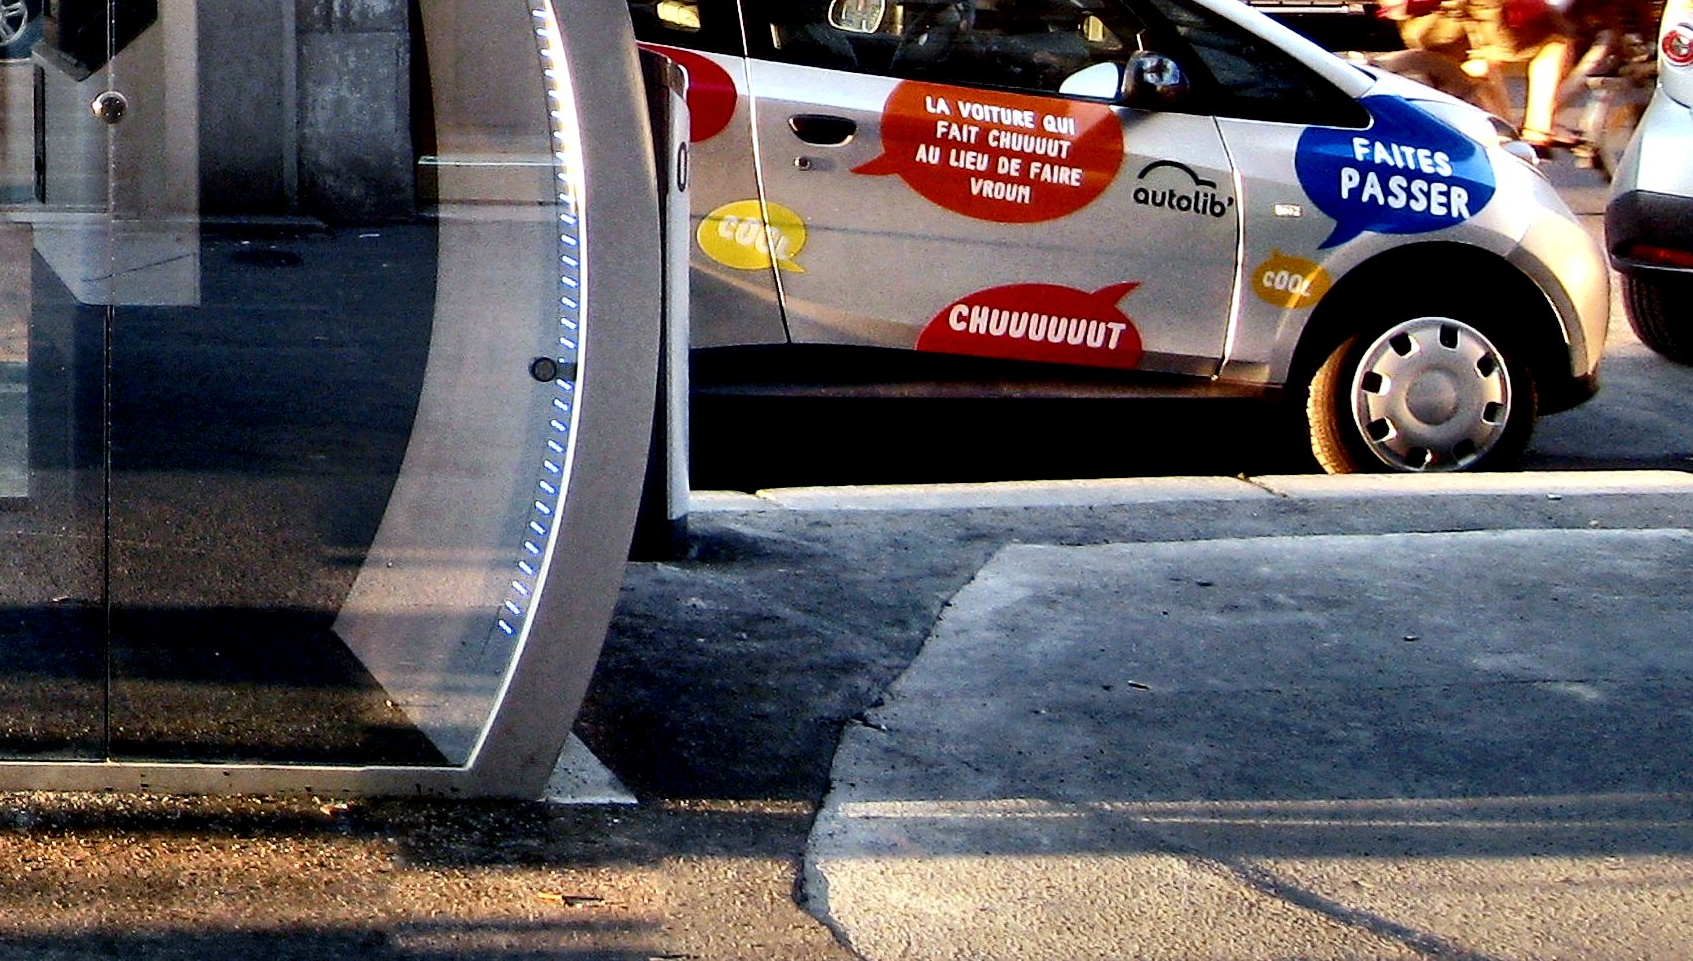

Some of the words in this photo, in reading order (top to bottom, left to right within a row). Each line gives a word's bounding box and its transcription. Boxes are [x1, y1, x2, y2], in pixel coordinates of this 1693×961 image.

[925, 96, 951, 116] LA
[958, 100, 1036, 129] VOITURE
[1043, 115, 1076, 136] QUI
[936, 120, 980, 144] FAIT
[988, 129, 1071, 159] CHUUUUT
[1352, 137, 1454, 178] FAITES
[915, 144, 941, 165] AU
[949, 149, 989, 172] LIEU
[997, 156, 1022, 177] DE
[1029, 162, 1083, 187] FAIRE
[970, 177, 1031, 204] VROUM
[1133, 187, 1234, 218] autolib'
[1340, 167, 1471, 220] PASSER
[948, 303, 1127, 350] CHUUUUUUT
